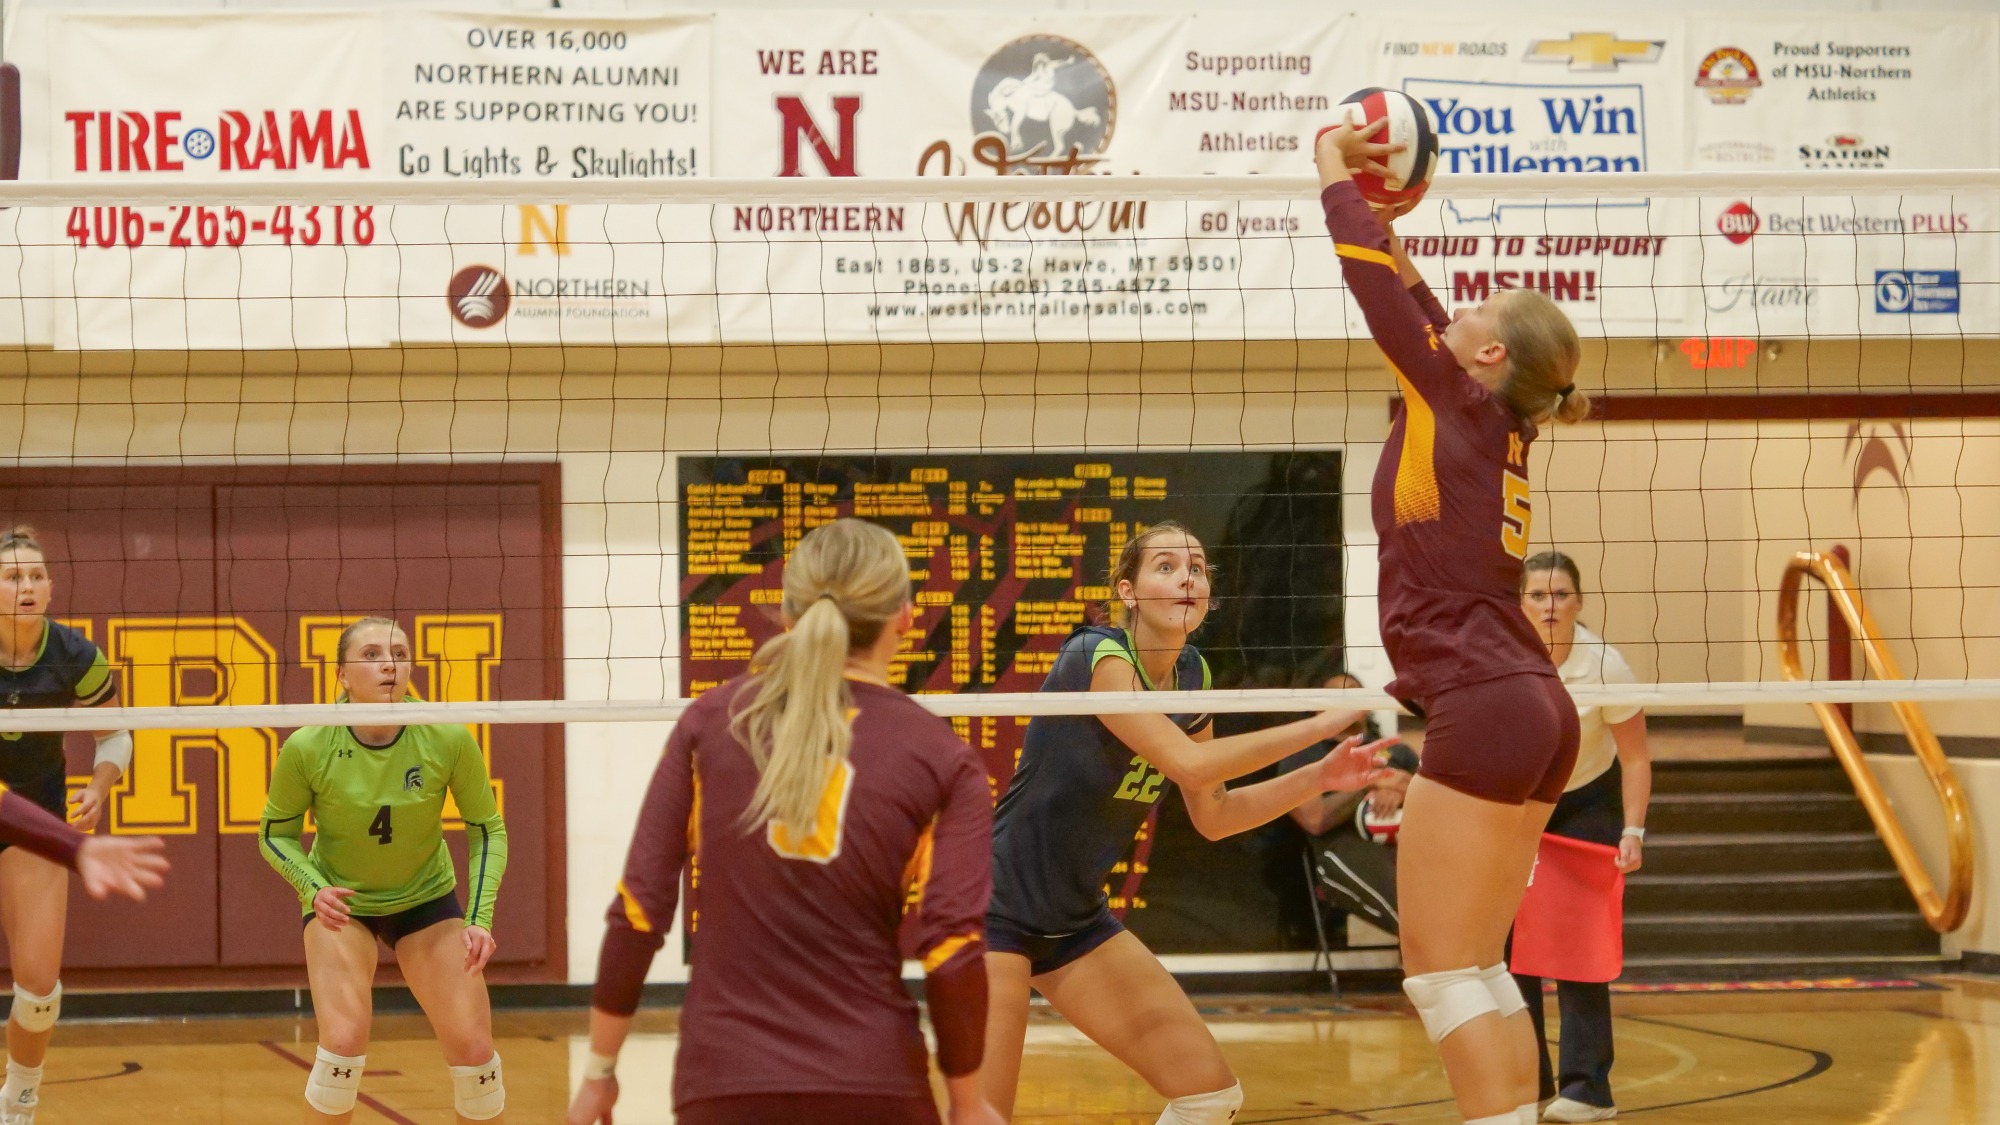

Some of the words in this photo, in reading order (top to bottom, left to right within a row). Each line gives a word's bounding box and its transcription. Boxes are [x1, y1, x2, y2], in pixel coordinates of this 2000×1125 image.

[467, 28, 535, 49] OVER
[545, 31, 627, 52] 16,000
[1383, 42, 1419, 56] FIND
[1458, 42, 1508, 56] ROADS
[1773, 42, 1820, 57] Proud
[1827, 42, 1911, 59] Supporters
[757, 50, 804, 75] WE
[818, 50, 878, 75] ARE
[1186, 51, 1312, 75] Supporting
[1771, 63, 1787, 78] of
[1794, 63, 1912, 79] MSU-Northern
[415, 64, 562, 85] NORTHERN
[572, 67, 679, 86] ALUMNI
[1168, 91, 1329, 111] MSU-Northern
[1807, 87, 1877, 101] Athletics
[396, 101, 446, 121] ARE
[454, 102, 625, 123] SUPPORTING
[633, 104, 698, 123] YOU!
[1424, 97, 1515, 134] You
[1540, 96, 1637, 134] Win
[65, 111, 184, 171] TIRE
[218, 109, 370, 171] RAMA
[771, 92, 864, 177] N
[1200, 132, 1299, 152] Athletics
[399, 144, 430, 176] Go
[443, 147, 521, 178] Lights
[536, 147, 559, 175] &
[571, 147, 697, 178] Skylights!
[1440, 143, 1640, 173] Tilleman
[733, 207, 905, 232] NORTHERN
[1200, 213, 1228, 232] 60
[1238, 214, 1299, 235] years
[1769, 213, 1815, 233] Best
[1820, 213, 1906, 233] Western
[1912, 213, 1969, 233] PLUS
[1400, 237, 1478, 256] ROUD
[1492, 237, 1525, 256] TO
[1535, 236, 1667, 256] SUPPORT
[836, 257, 882, 273] East
[897, 257, 959, 275] 1865,
[1044, 256, 1117, 274] Havre,
[1129, 257, 1159, 271] MT
[1168, 256, 1236, 271] 59501
[514, 278, 650, 299] NORTHERN
[904, 280, 977, 295] Phone:
[990, 280, 1051, 297] (406)
[1707, 273, 1818, 313] Havre
[514, 307, 560, 320] ALUMNI
[565, 307, 650, 320] FOUNDATION
[1501, 469, 1532, 560] 5
[1113, 755, 1165, 803] 22
[368, 805, 393, 845] 4
